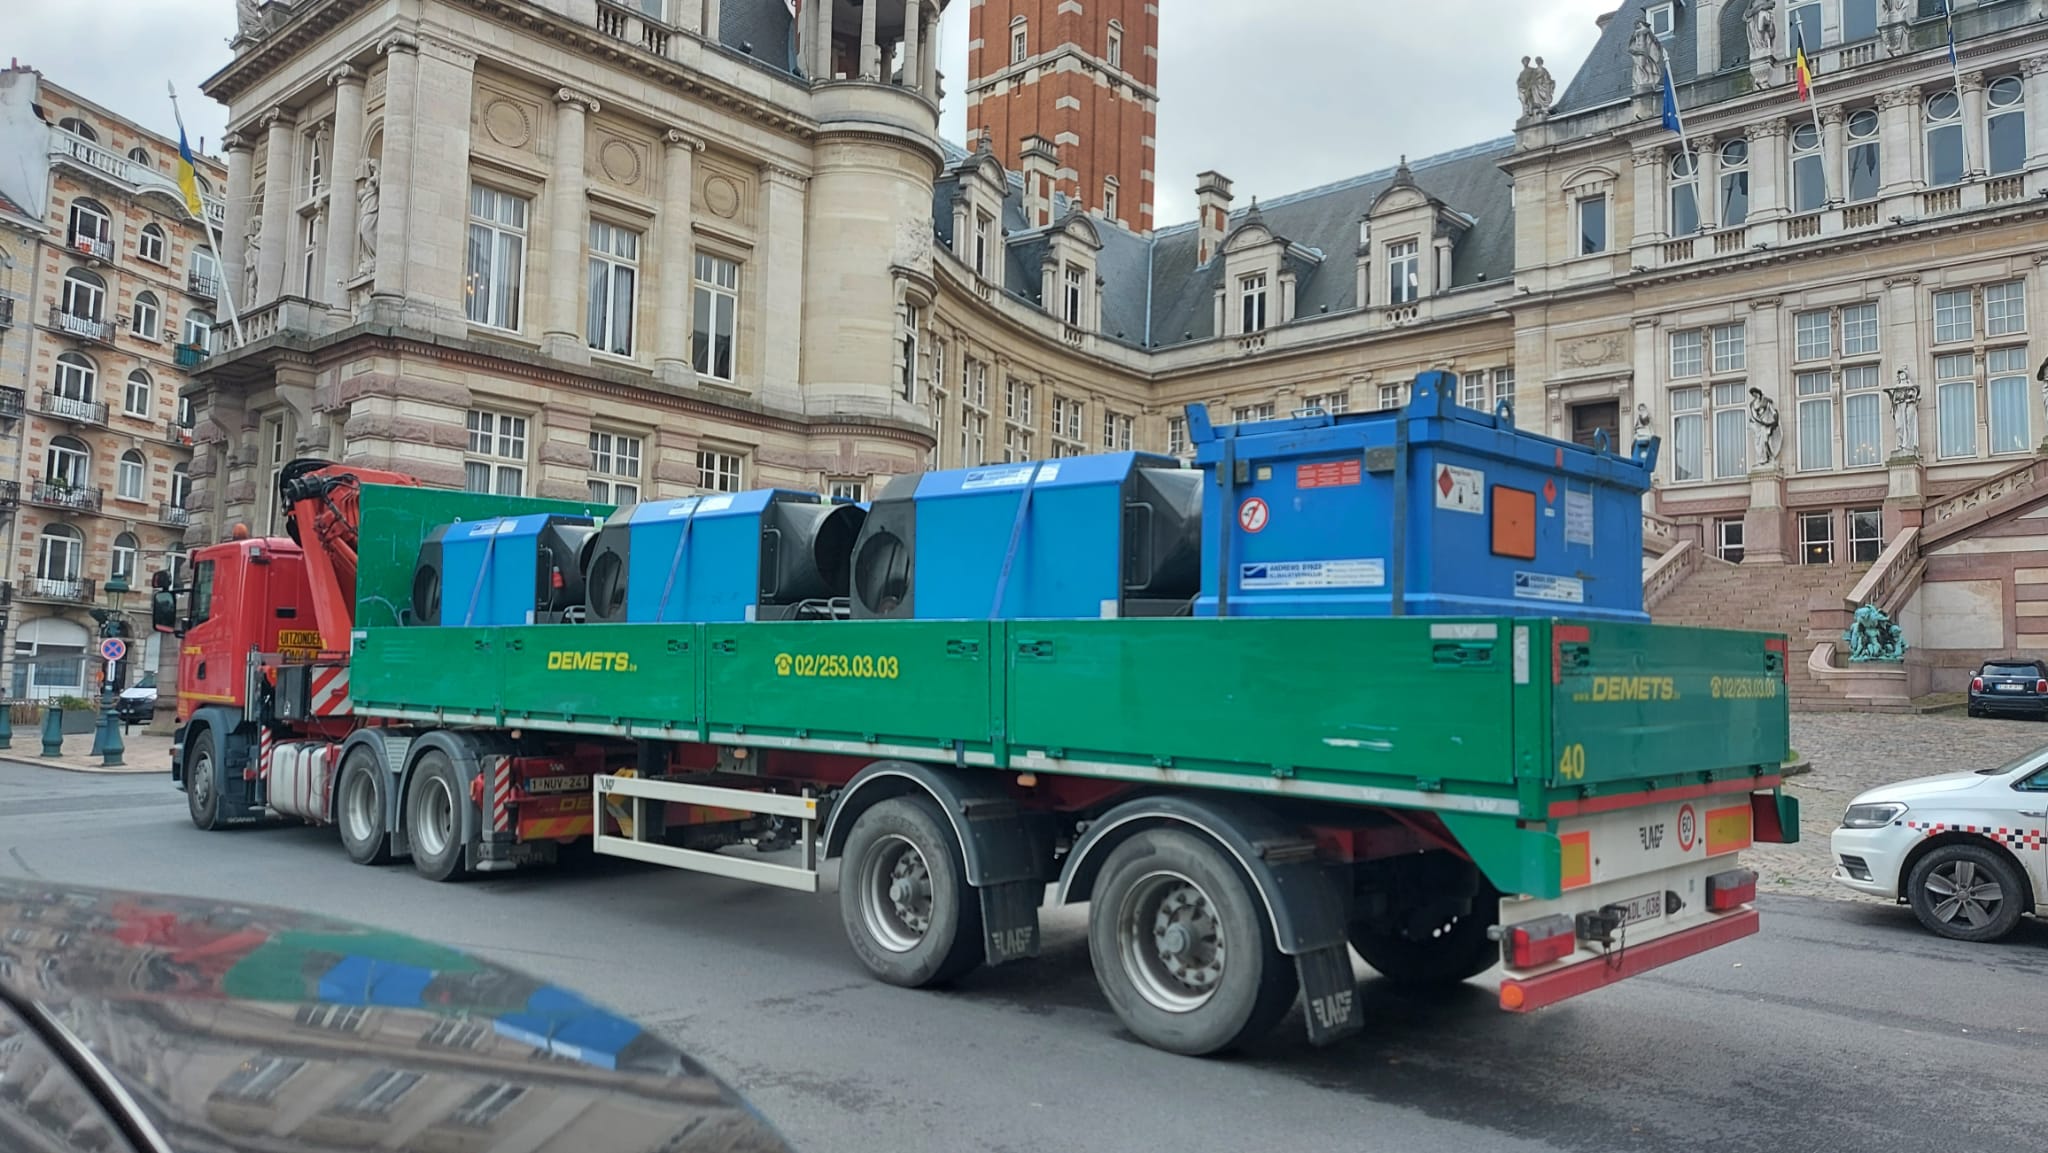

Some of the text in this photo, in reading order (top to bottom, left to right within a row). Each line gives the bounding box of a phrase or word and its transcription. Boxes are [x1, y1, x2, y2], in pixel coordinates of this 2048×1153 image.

[795, 654, 898, 679] 02/253.03.03
[1559, 744, 1585, 779] 40
[1682, 815, 1692, 833] 60
